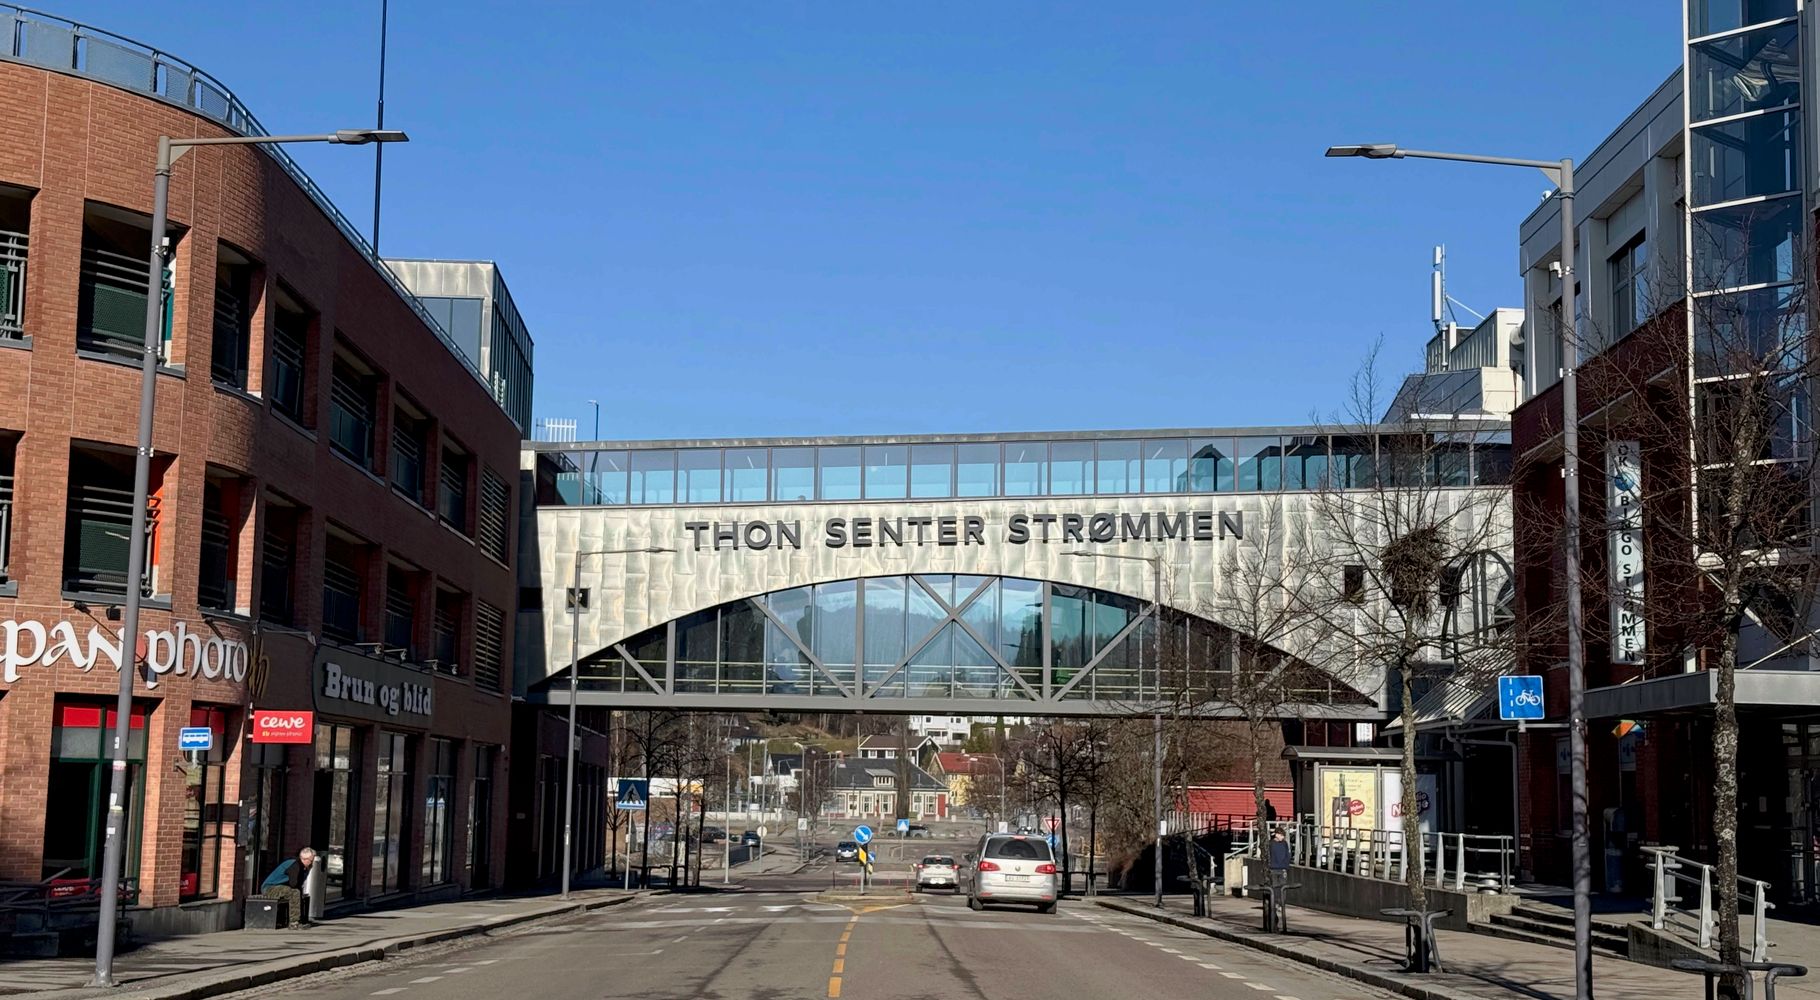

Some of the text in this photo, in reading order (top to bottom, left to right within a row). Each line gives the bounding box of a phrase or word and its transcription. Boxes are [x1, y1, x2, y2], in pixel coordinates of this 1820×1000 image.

[685, 510, 1244, 551] THON SENTER STRØMMEN
[324, 662, 432, 716] Brun og blid
[260, 716, 306, 729] cewe
